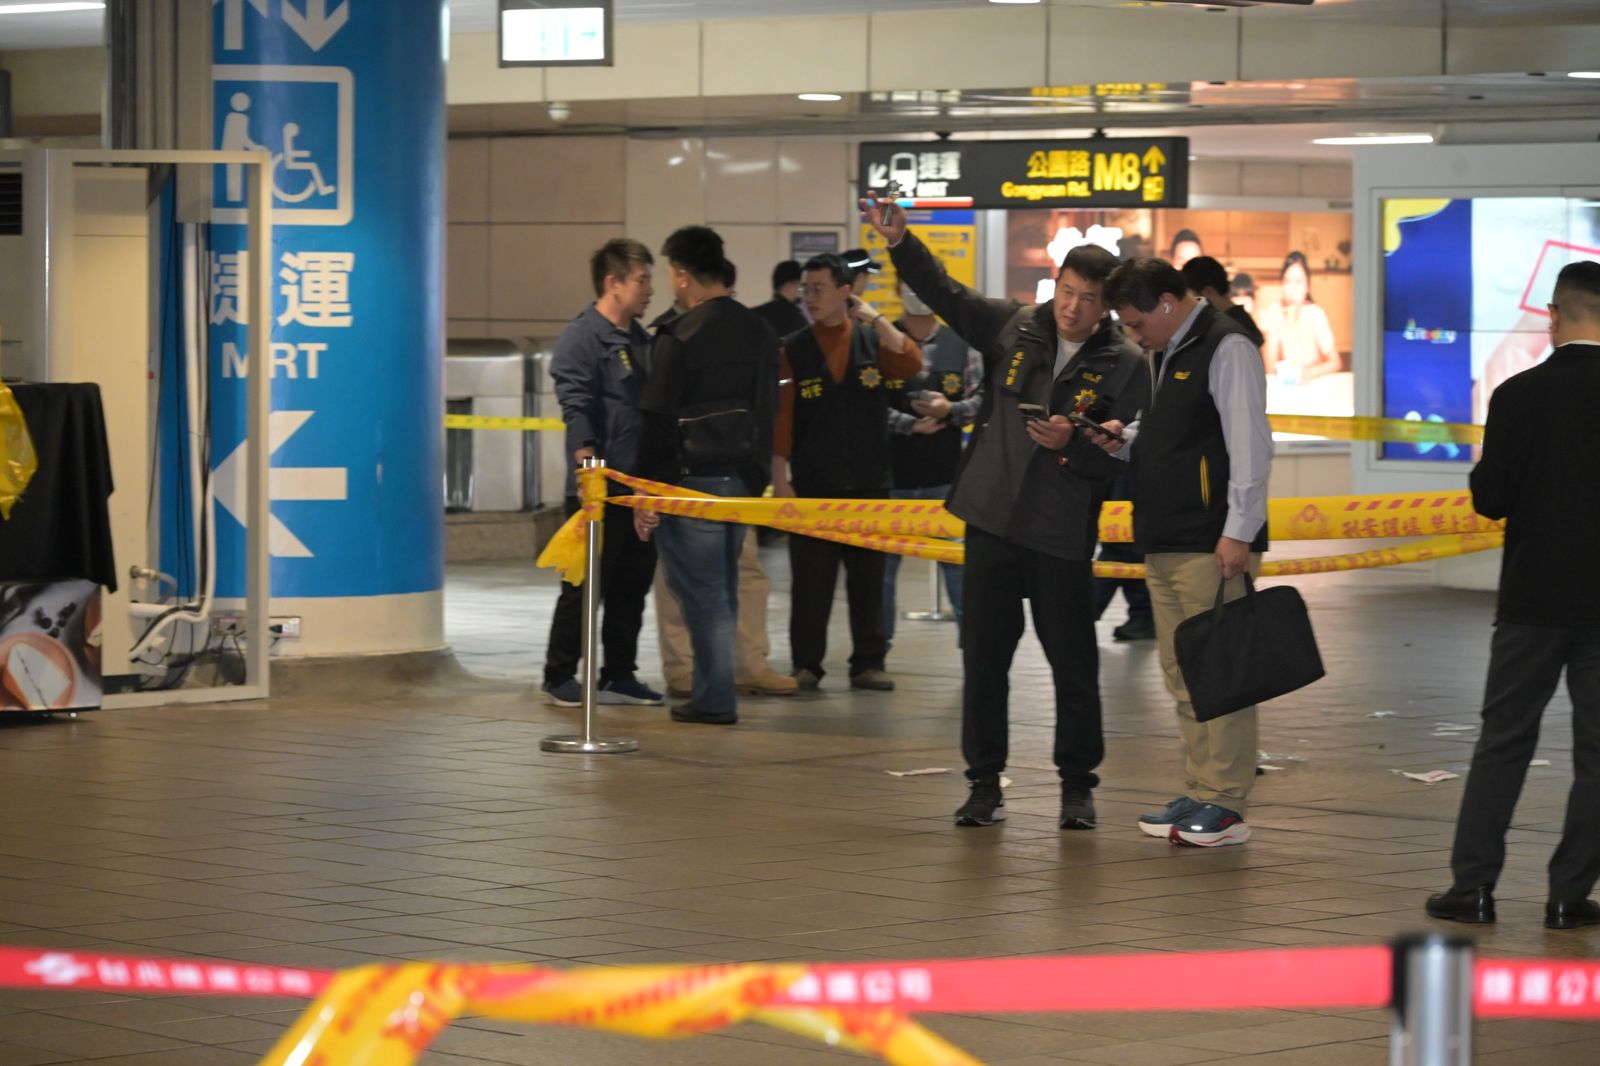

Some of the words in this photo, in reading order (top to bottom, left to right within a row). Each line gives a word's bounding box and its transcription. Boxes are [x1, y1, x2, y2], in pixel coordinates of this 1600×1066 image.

[1093, 153, 1141, 191] M8
[221, 342, 328, 379] MRT
[1481, 966, 1600, 1006] 捷運公
